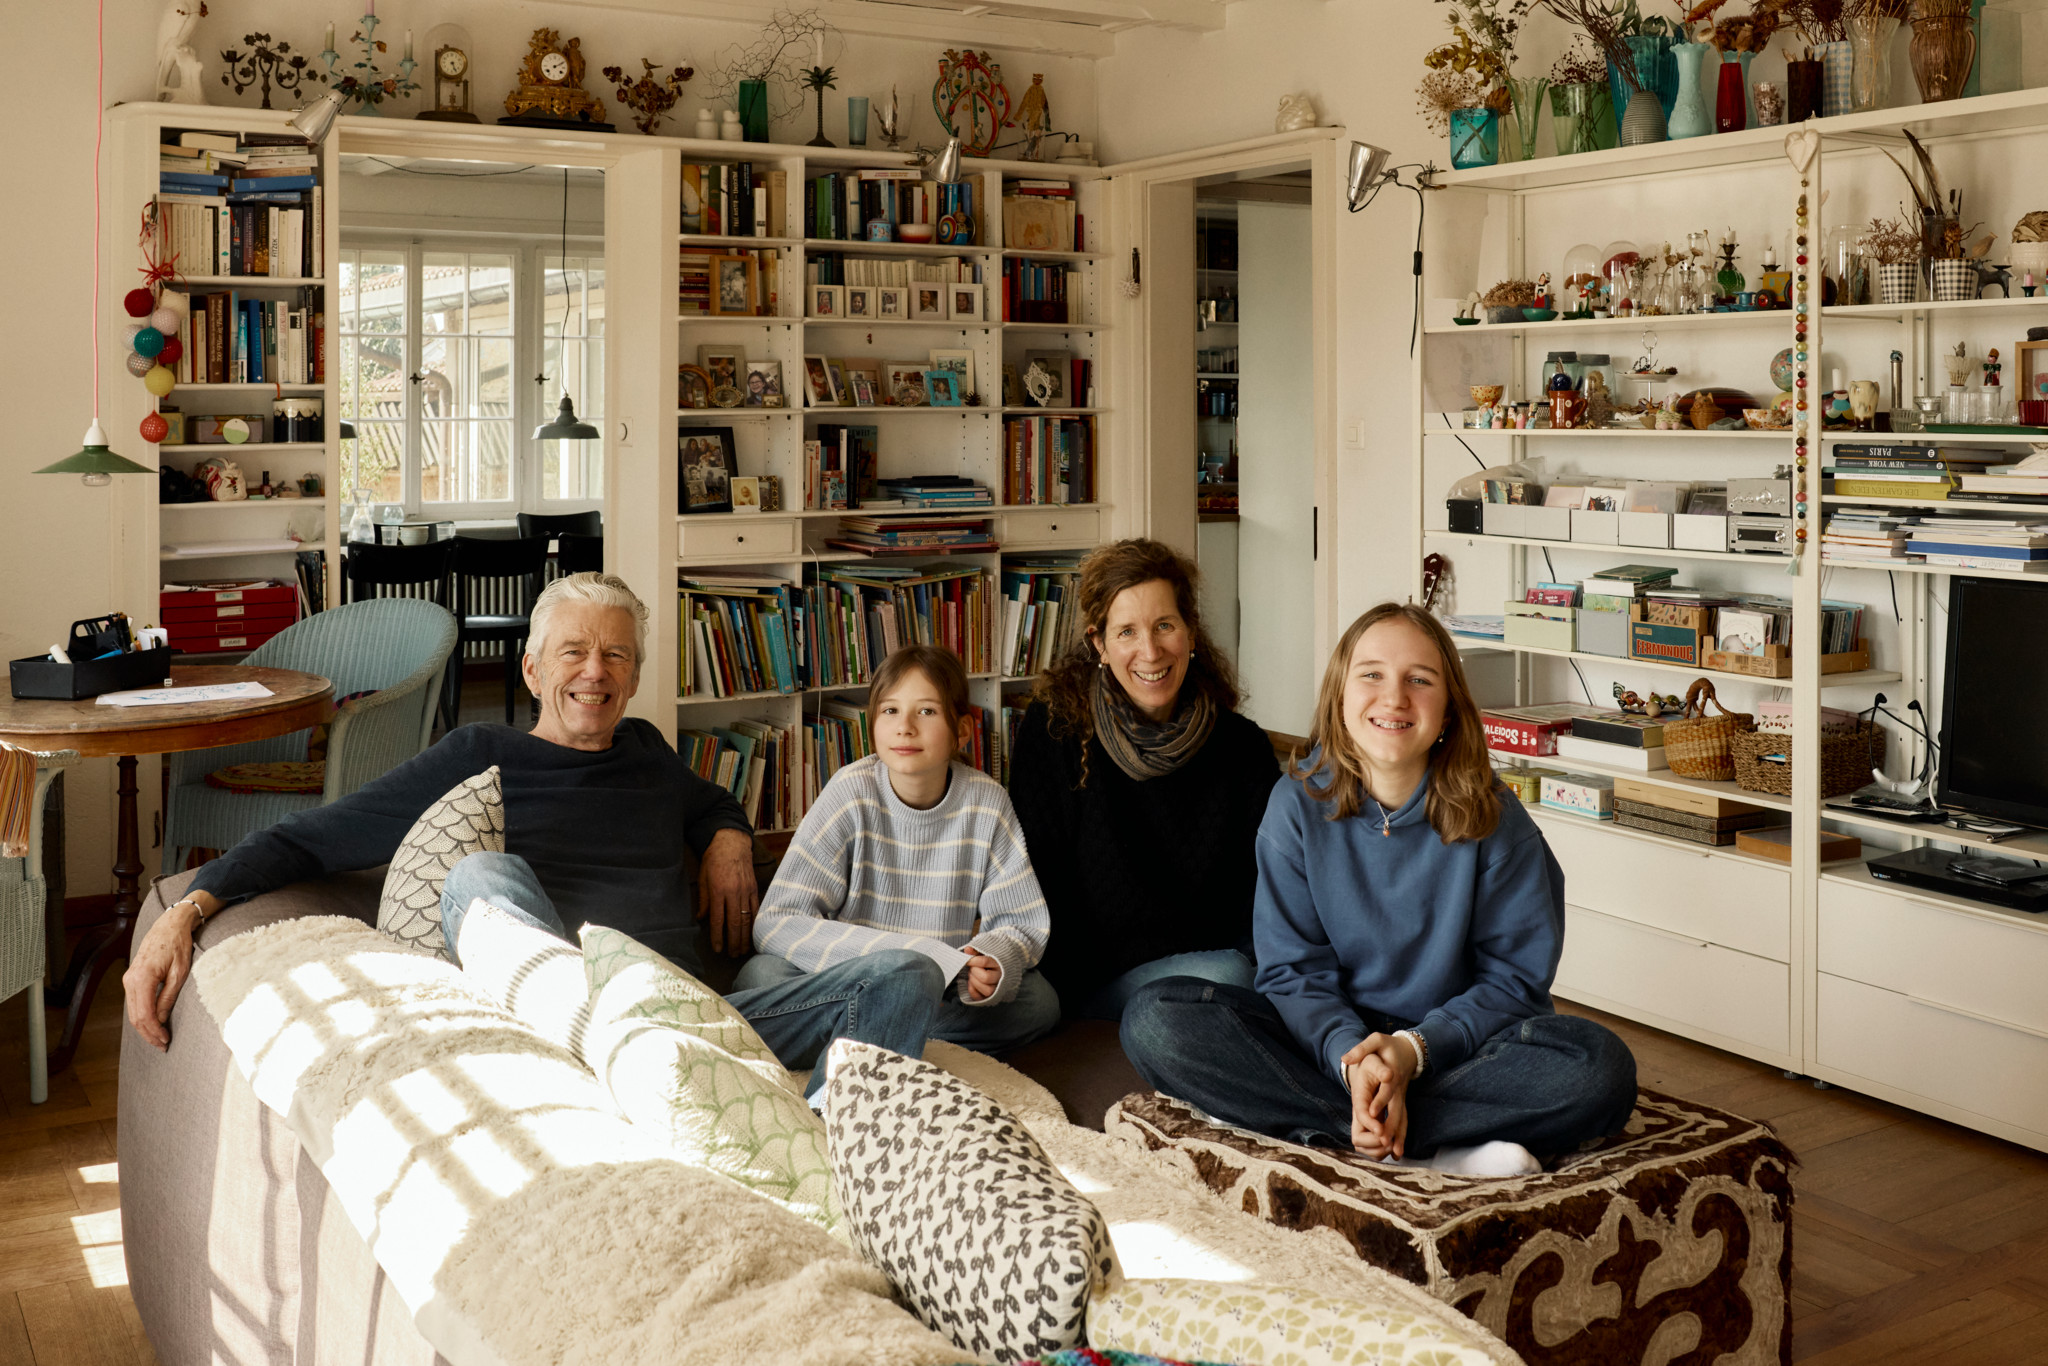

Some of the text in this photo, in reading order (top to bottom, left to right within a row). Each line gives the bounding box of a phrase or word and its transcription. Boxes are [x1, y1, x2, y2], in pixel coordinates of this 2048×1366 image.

[1869, 447, 1892, 456] PARIS
[1868, 460, 1887, 468] YORK
[1850, 486, 1919, 497] DER GARTEN EDEN
[1482, 724, 1519, 745] ALEIDOS
[1490, 735, 1506, 746] Junior
